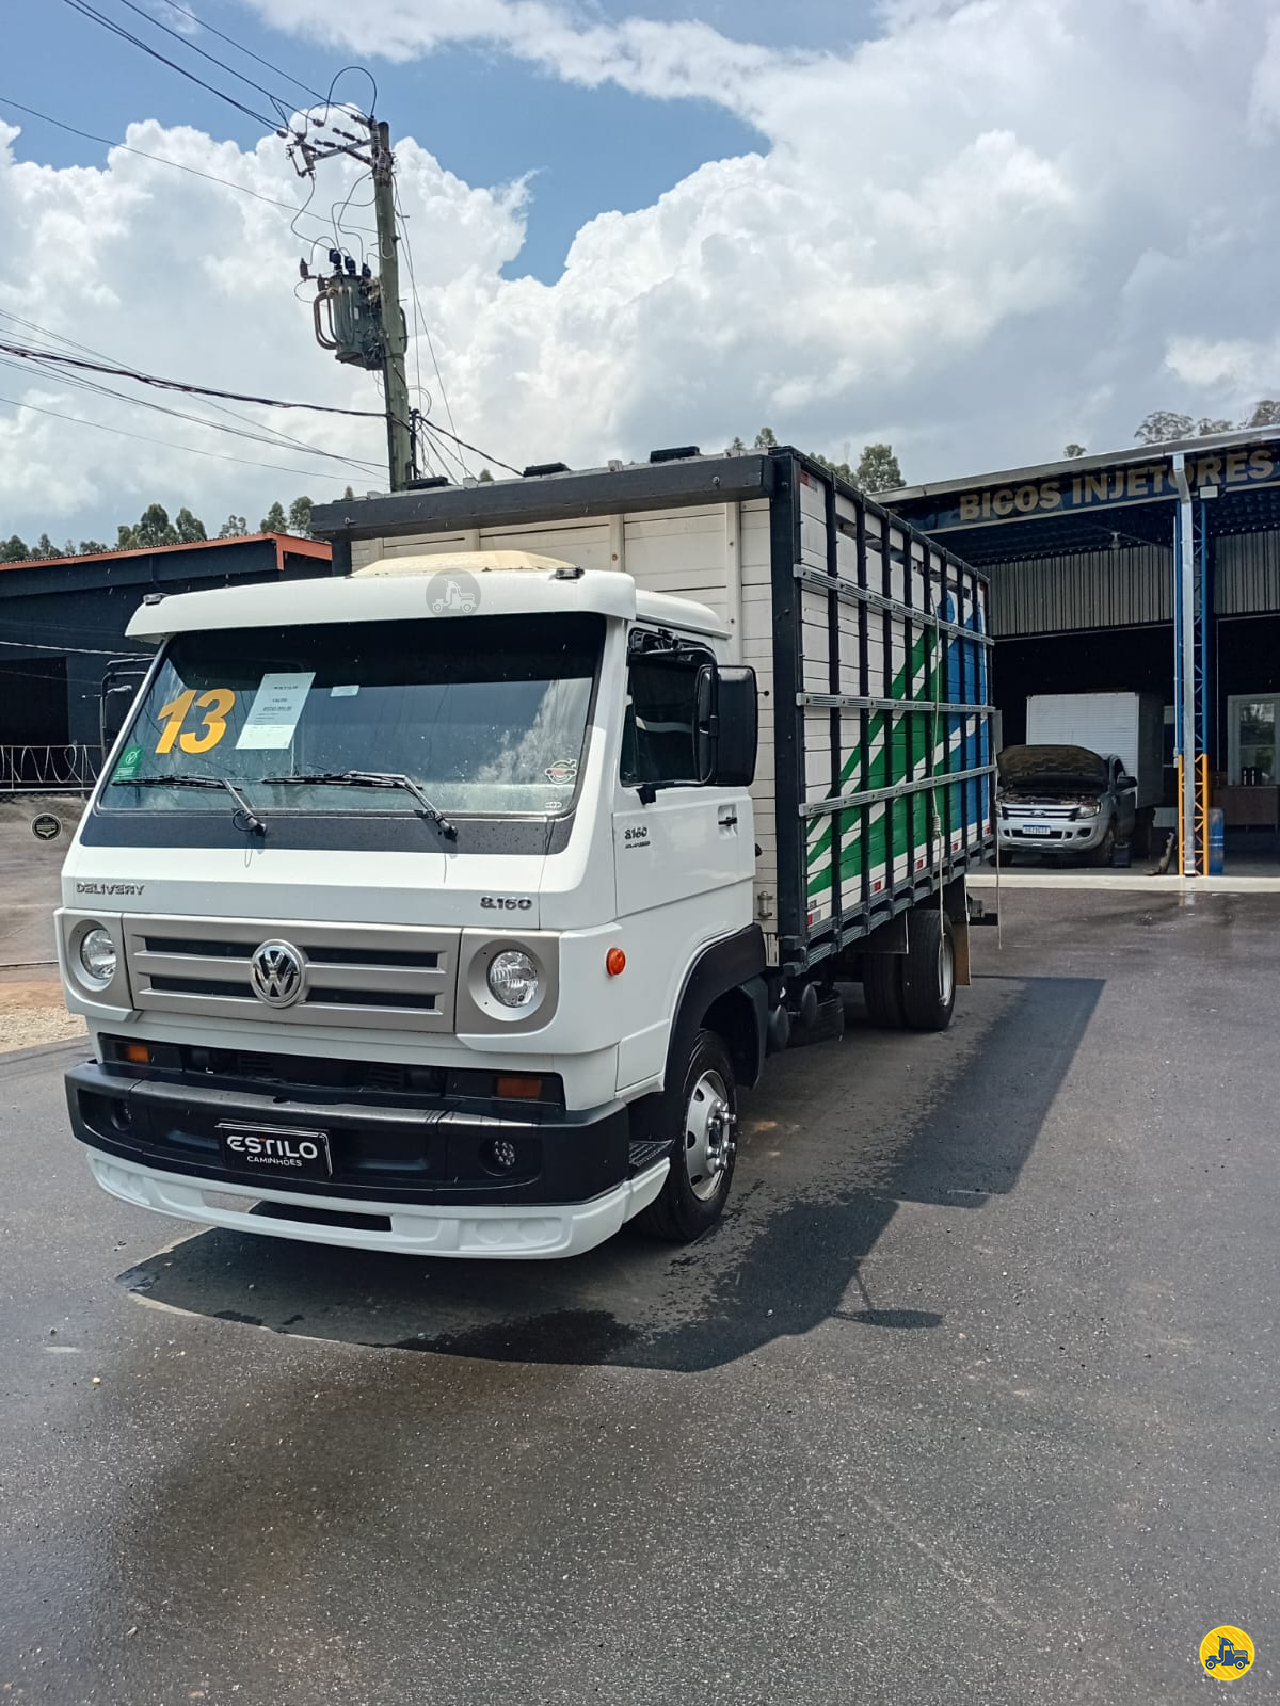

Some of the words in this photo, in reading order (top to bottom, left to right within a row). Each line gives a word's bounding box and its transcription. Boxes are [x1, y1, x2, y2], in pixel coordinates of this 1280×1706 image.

[959, 481, 1062, 521] BICOS
[1072, 451, 1274, 504] INJETORES
[155, 688, 236, 755] 13
[76, 882, 145, 896] DELIVERY
[226, 1135, 318, 1160] ESTILO
[246, 1155, 303, 1167] CAMINHÕES
